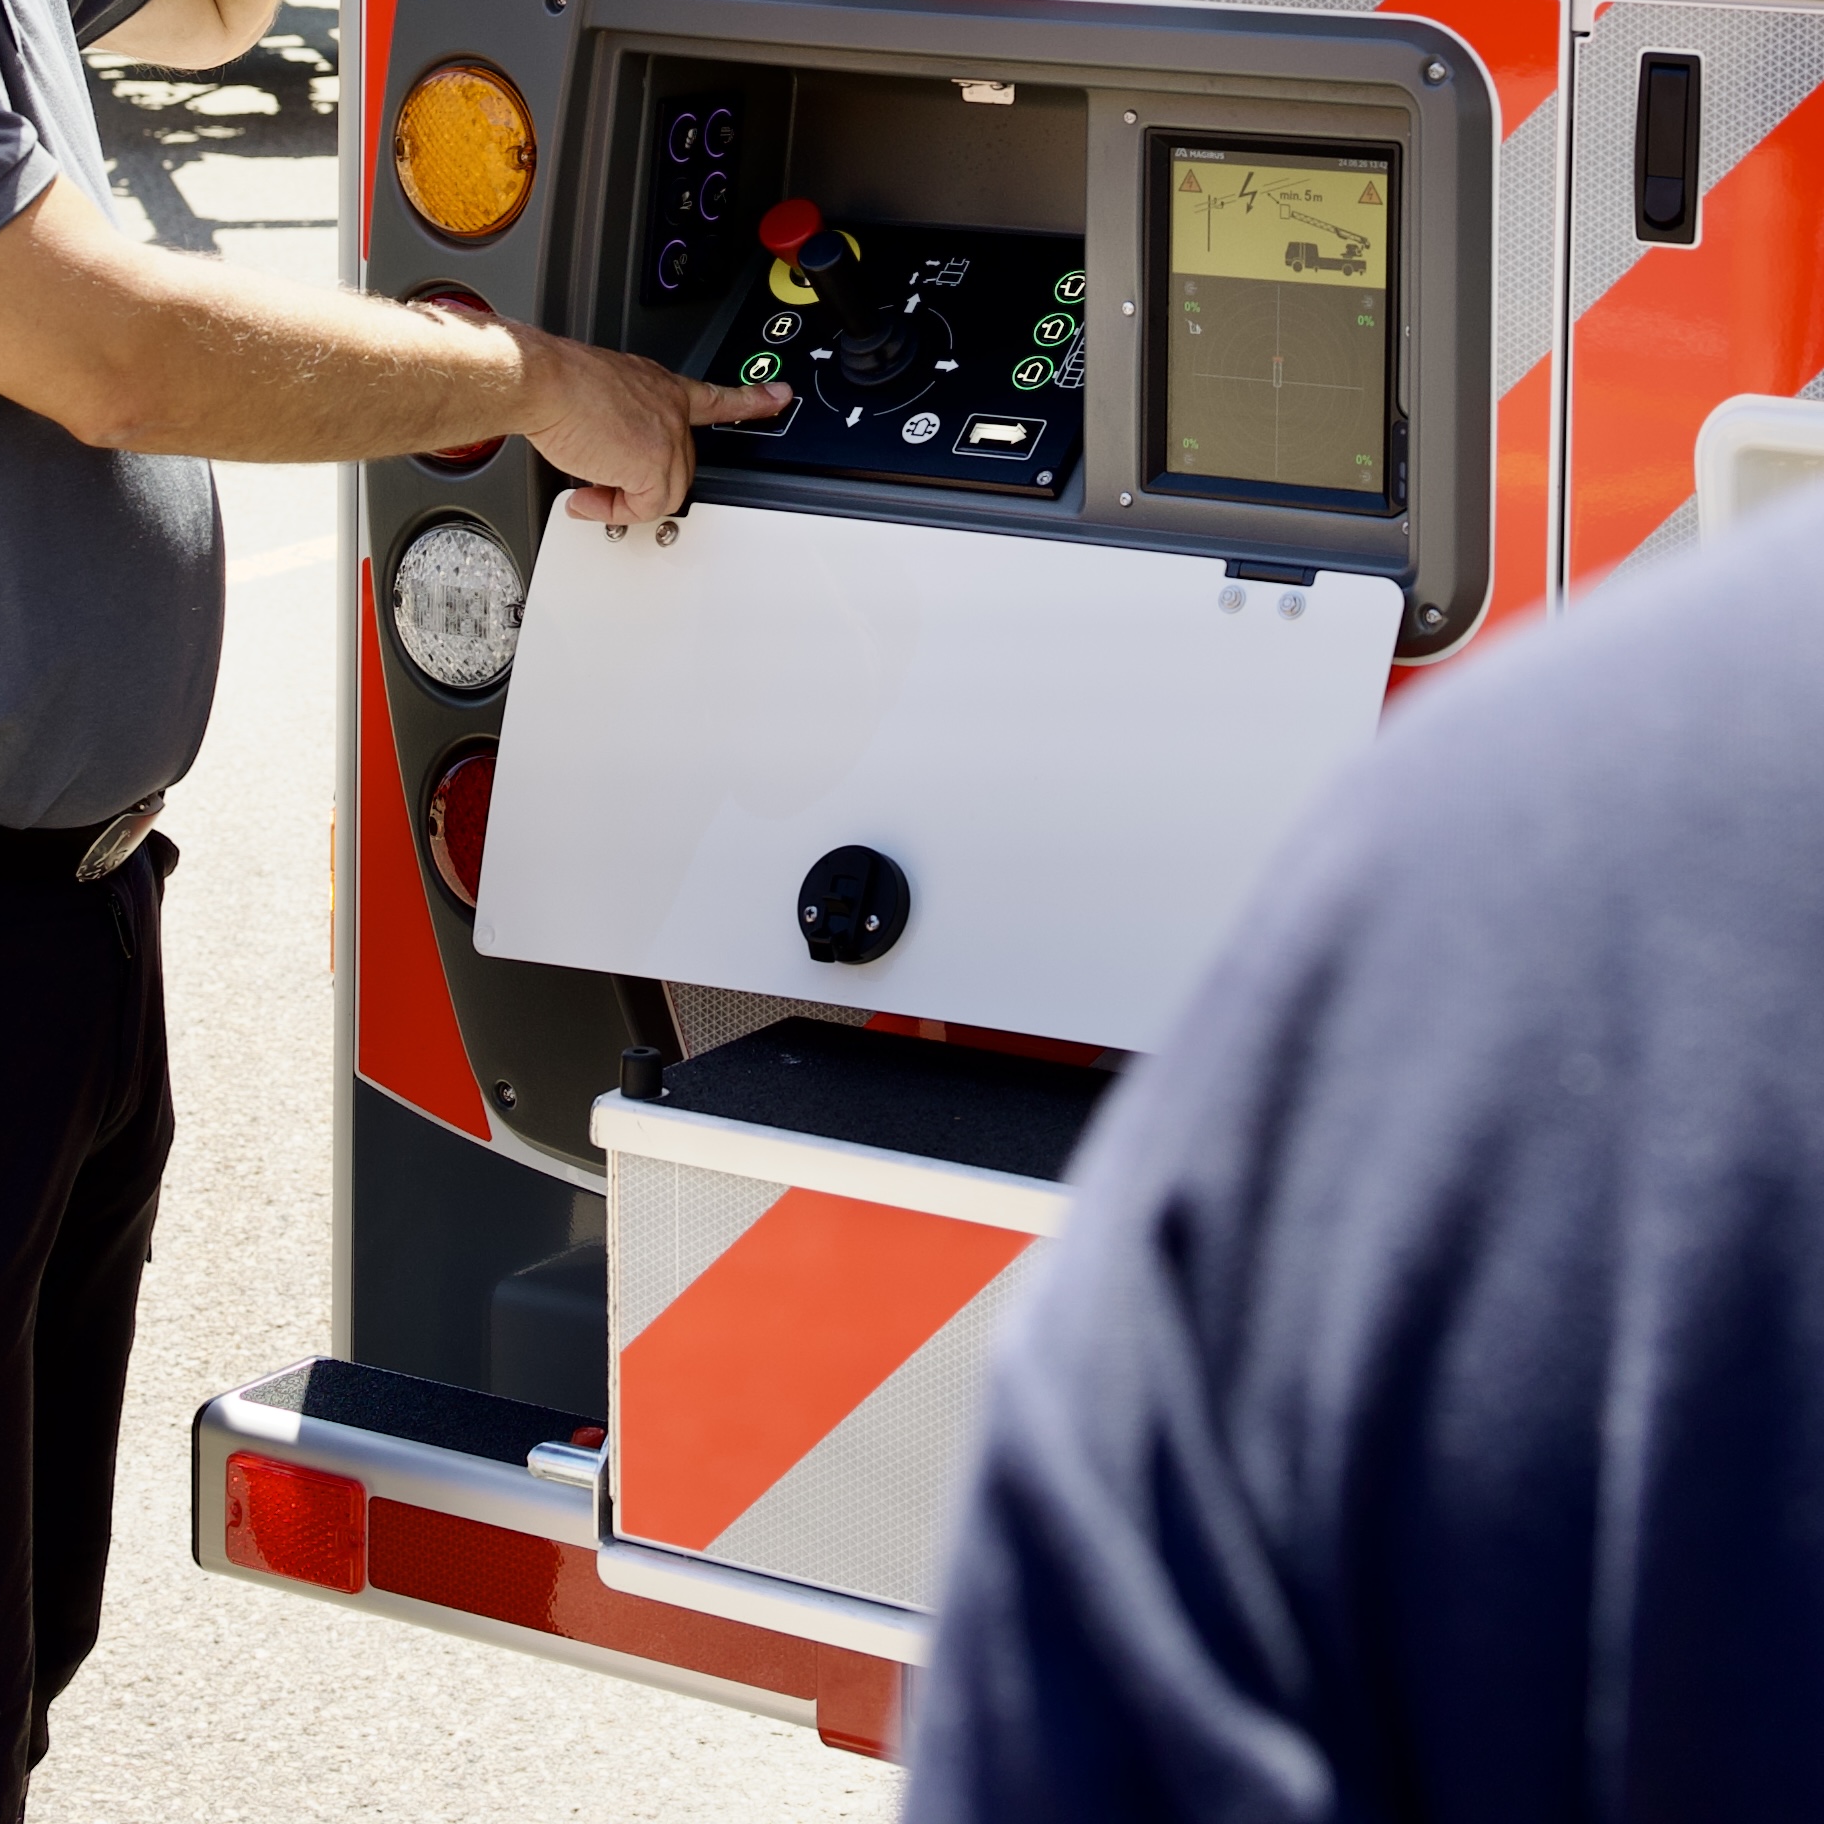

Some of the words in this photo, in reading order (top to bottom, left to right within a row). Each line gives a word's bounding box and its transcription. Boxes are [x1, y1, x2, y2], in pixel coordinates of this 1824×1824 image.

[1279, 190, 1302, 201] min.
[1184, 301, 1201, 313] 0%
[1357, 315, 1374, 327] 0%
[1182, 438, 1199, 450] 0%
[1355, 454, 1372, 466] 0%
